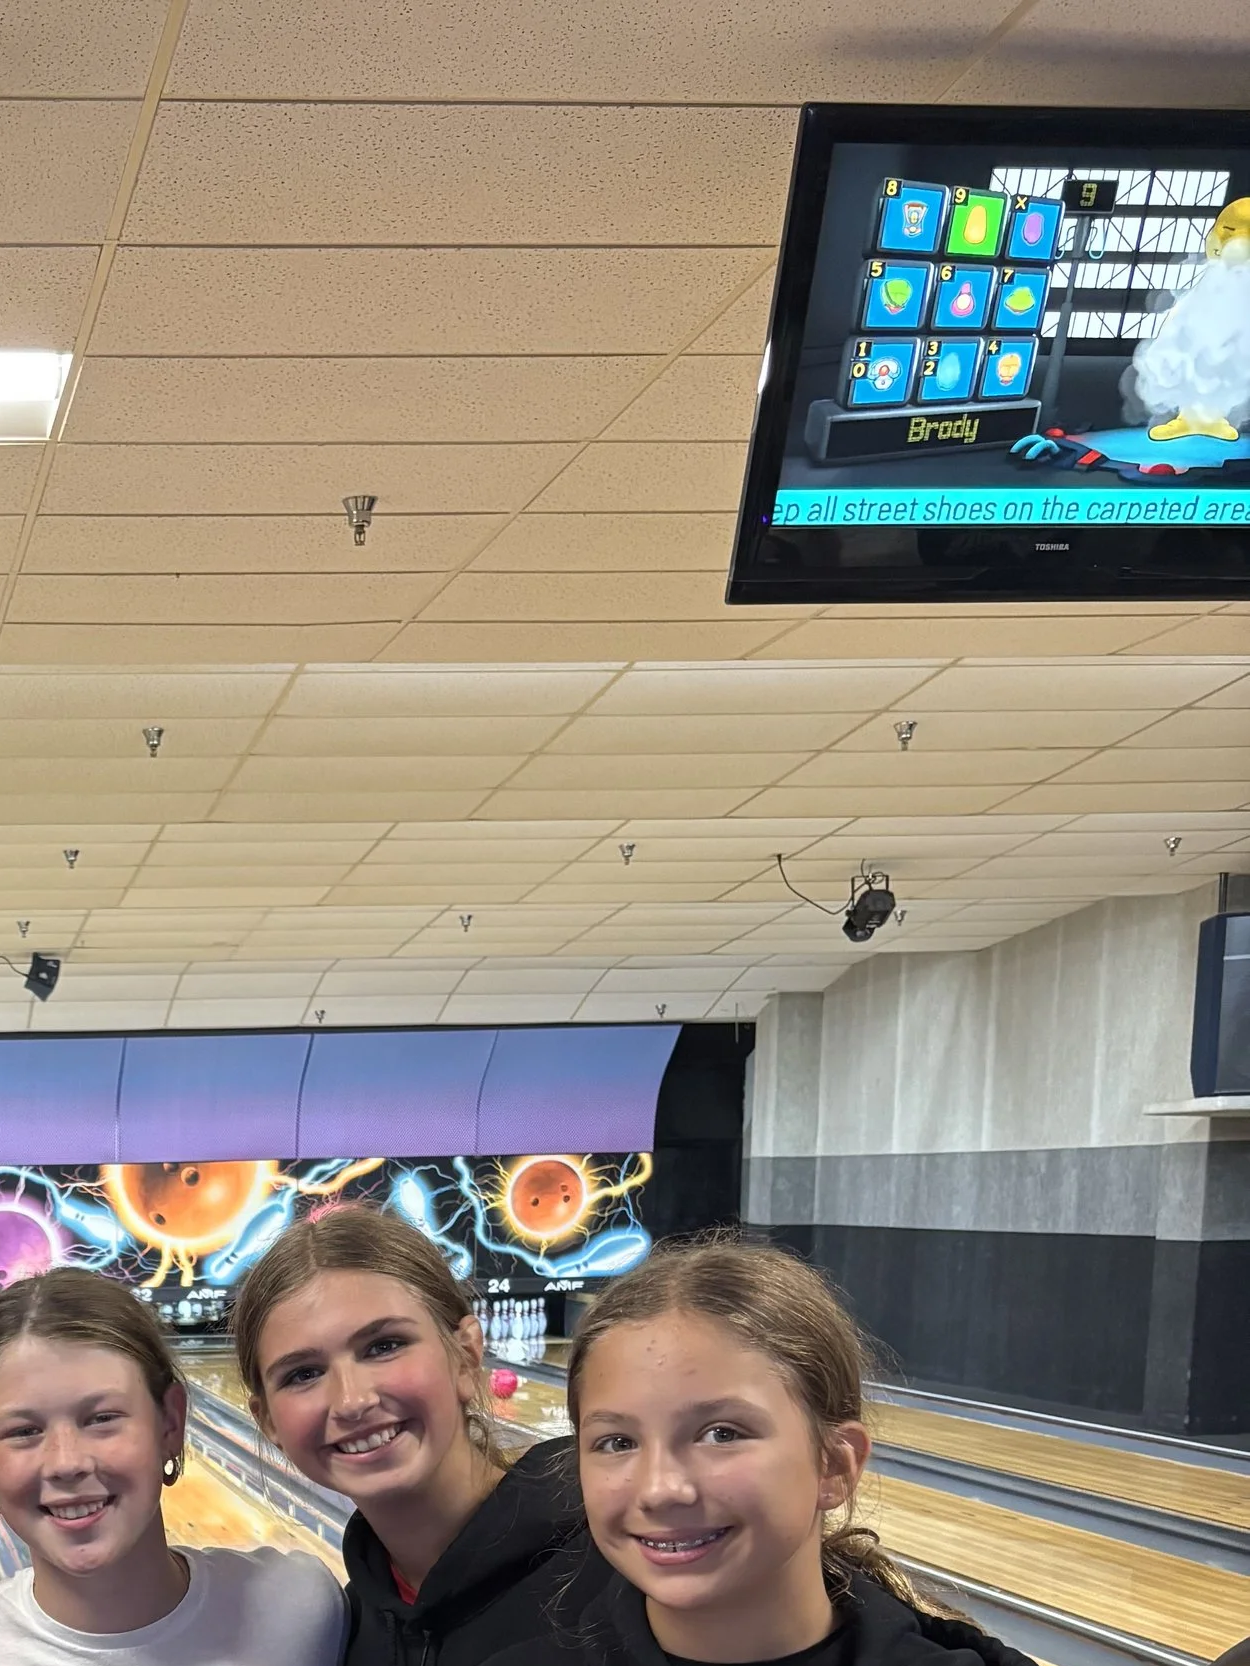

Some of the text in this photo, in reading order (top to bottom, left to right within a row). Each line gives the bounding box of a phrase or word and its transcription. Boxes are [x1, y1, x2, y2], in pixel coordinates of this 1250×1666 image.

[885, 179, 1098, 210] 8 9 X 9
[870, 262, 1014, 284] 5 6 7
[857, 339, 999, 358] 1 3 4
[851, 360, 937, 379] 0 2
[906, 413, 980, 444] Brody
[806, 495, 838, 522] all
[842, 497, 919, 522] street
[922, 494, 997, 522] shoes
[1003, 501, 1034, 521] on
[1040, 494, 1080, 521] the
[1086, 495, 1200, 524] carpeted
[1035, 543, 1070, 552] TOSHIBA
[186, 1288, 228, 1300] AMF
[487, 1278, 585, 1293] 24 AMF
